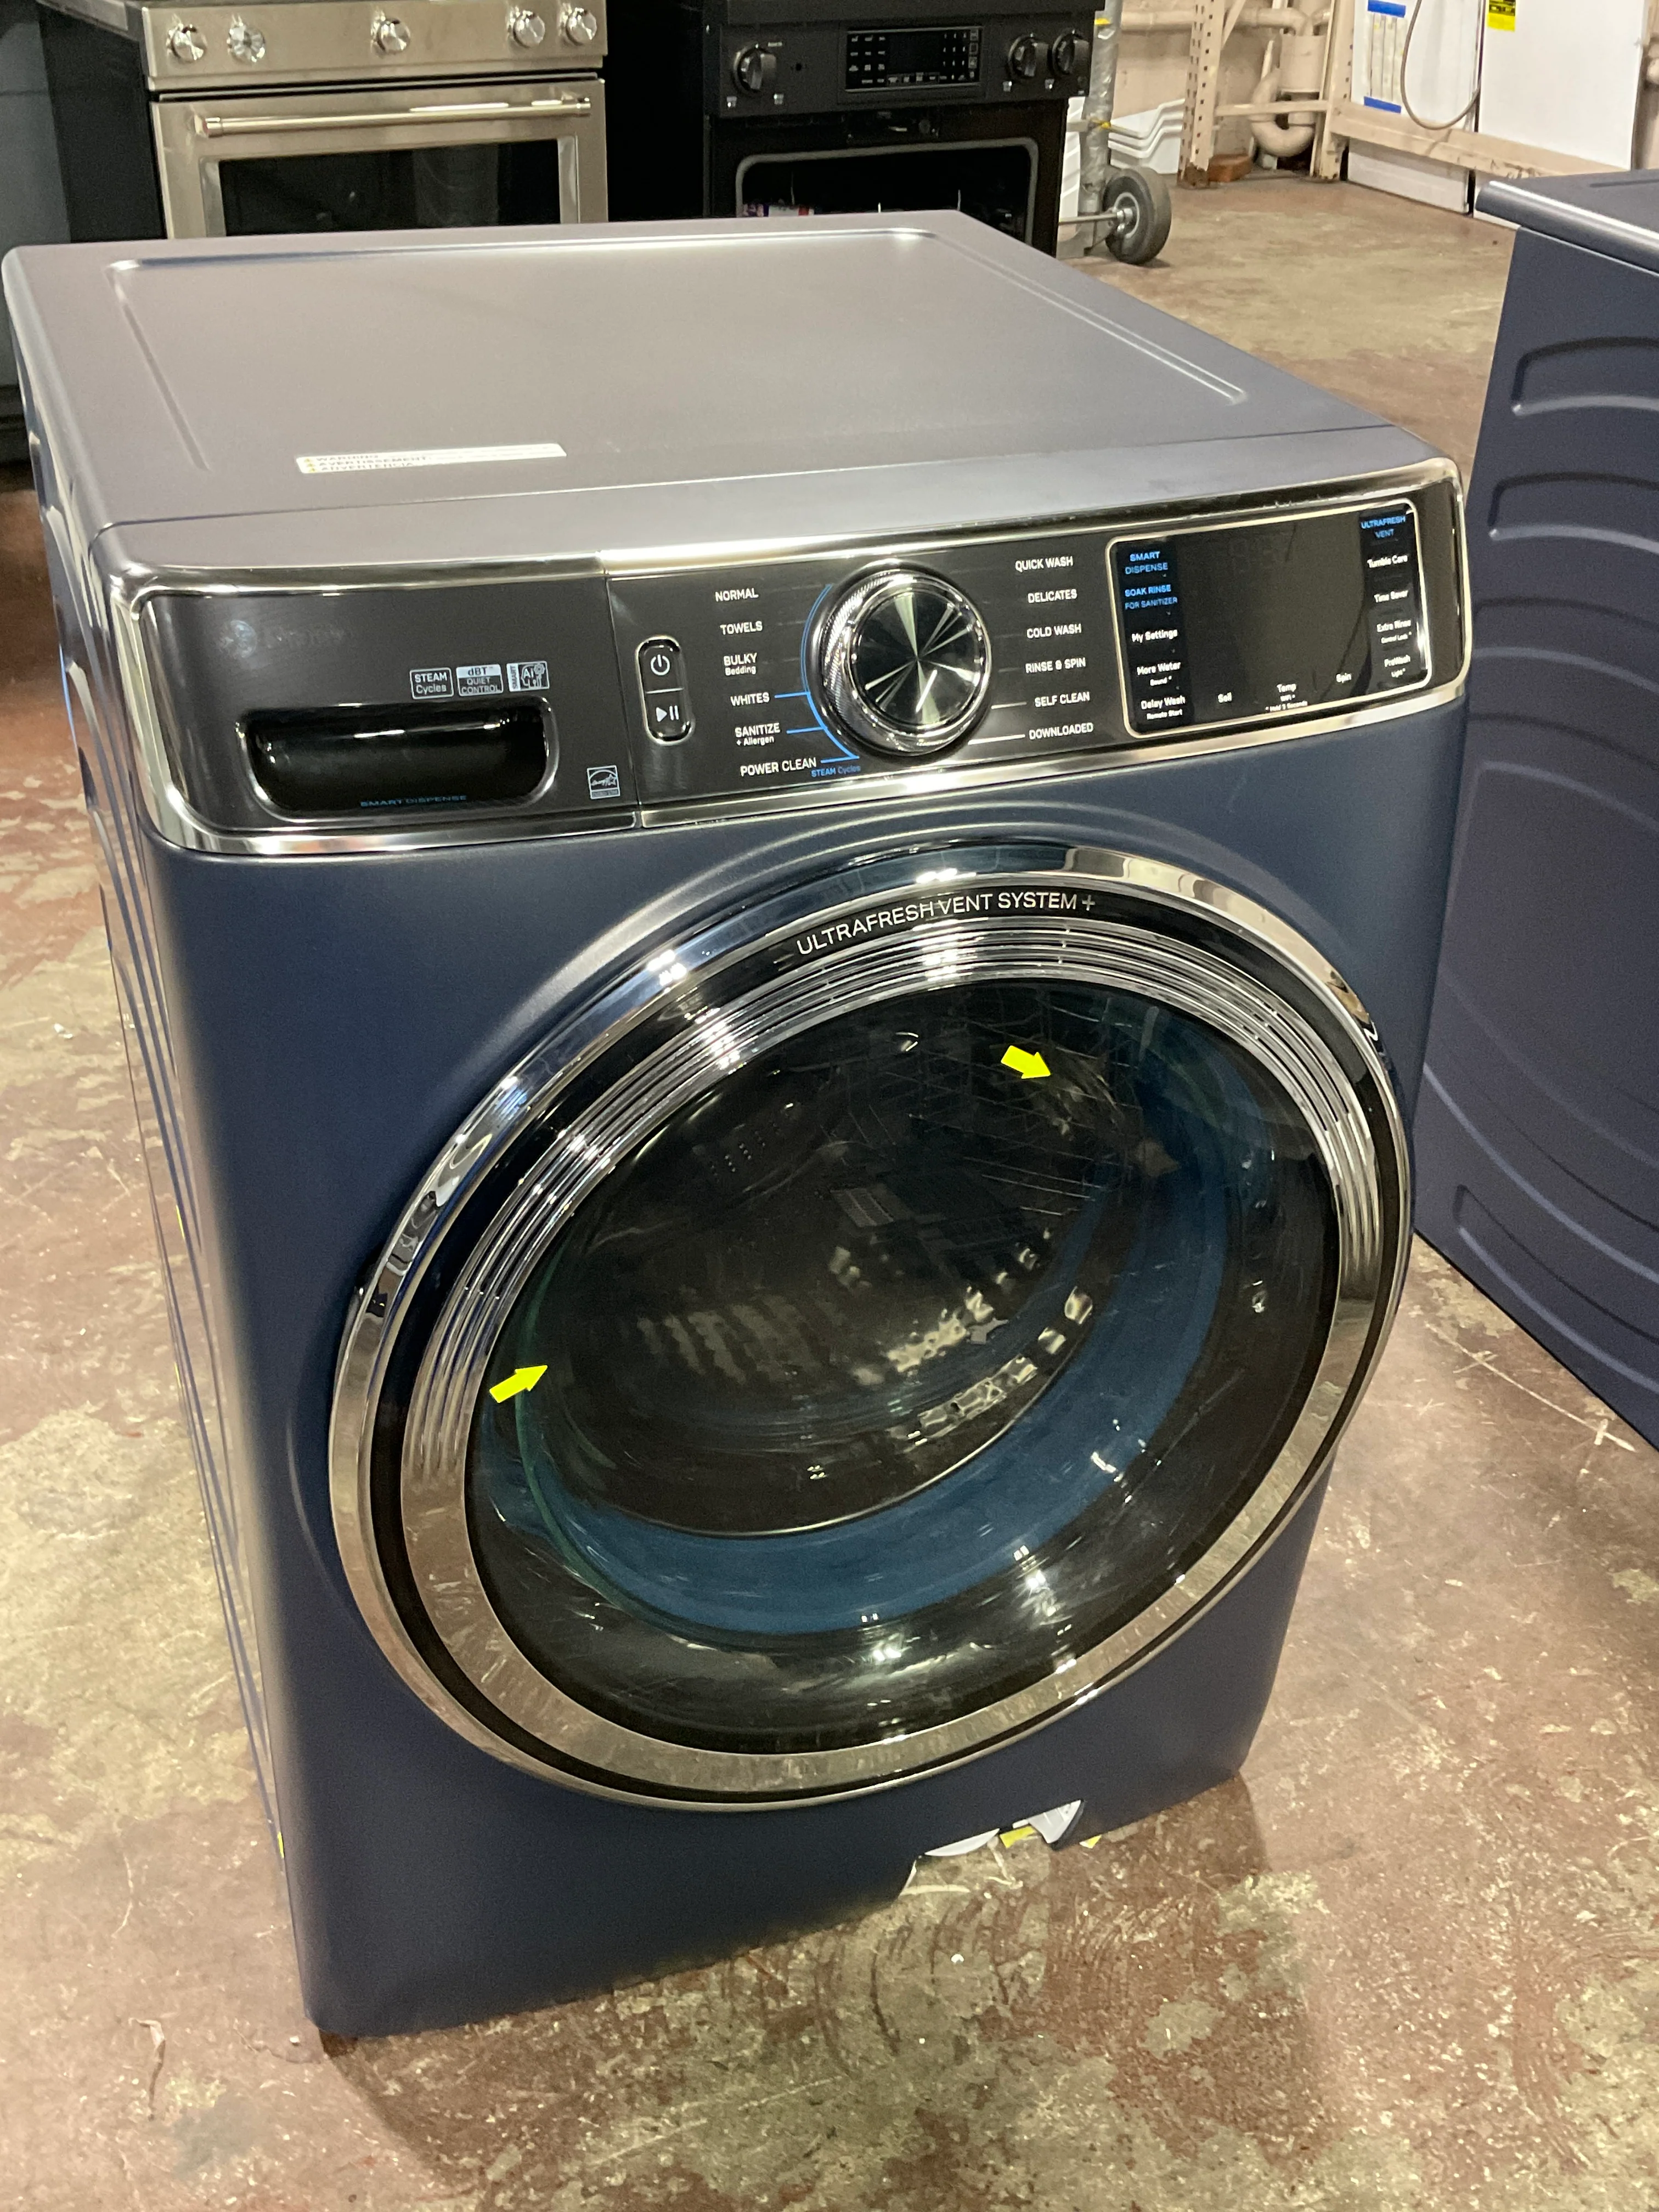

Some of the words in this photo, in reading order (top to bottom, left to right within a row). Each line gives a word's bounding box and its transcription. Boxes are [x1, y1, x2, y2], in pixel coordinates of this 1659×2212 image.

[1361, 516, 1406, 529] ULTRAFRESH
[1374, 528, 1394, 538] VENT
[1130, 551, 1160, 562] SMART
[1392, 555, 1408, 564] Care
[1015, 558, 1044, 572] QUICK
[1045, 556, 1074, 568] WASH
[1125, 562, 1168, 574] DISPENSE
[715, 588, 759, 602] NORMAL
[1028, 589, 1077, 603] DELICATES
[1125, 588, 1147, 597] SOAK
[1148, 584, 1171, 594] RINSE
[1125, 601, 1139, 610] FOR
[1141, 597, 1178, 607] SANITIZER
[720, 621, 763, 635] TOWELS
[1026, 627, 1052, 639] COLD
[1053, 624, 1082, 635] WASH
[1132, 633, 1143, 644] My
[1145, 629, 1178, 640] Settings
[723, 653, 757, 667] BULKY
[1025, 661, 1053, 673] RINSE
[1063, 657, 1086, 669] SPIN
[725, 665, 756, 676] Bedding
[1137, 665, 1156, 675] More
[1158, 662, 1181, 672] Water
[415, 672, 448, 684] STEAM
[466, 676, 490, 685] QUIET
[1336, 672, 1352, 683] Spin
[416, 684, 447, 695] Cycles
[461, 684, 500, 695] CONTROL
[1277, 683, 1297, 693] Temp
[730, 692, 770, 706] WHITES
[1034, 695, 1057, 707] SELF
[1059, 692, 1090, 704] CLEAN
[1141, 699, 1163, 709] Delay
[1164, 695, 1186, 706] Wash
[1217, 692, 1232, 703] Soil
[735, 723, 780, 738] SANITIZE
[1029, 723, 1094, 740] DOWNLOADED
[743, 735, 775, 747] Allergen
[740, 761, 781, 777] POWER
[782, 758, 816, 772] CLEAN
[811, 767, 836, 777] STEAM
[838, 765, 861, 776] Cycles
[797, 900, 935, 956] ULTRAFRESH
[939, 894, 993, 915] VENT
[998, 891, 1077, 910] SYSTEM
